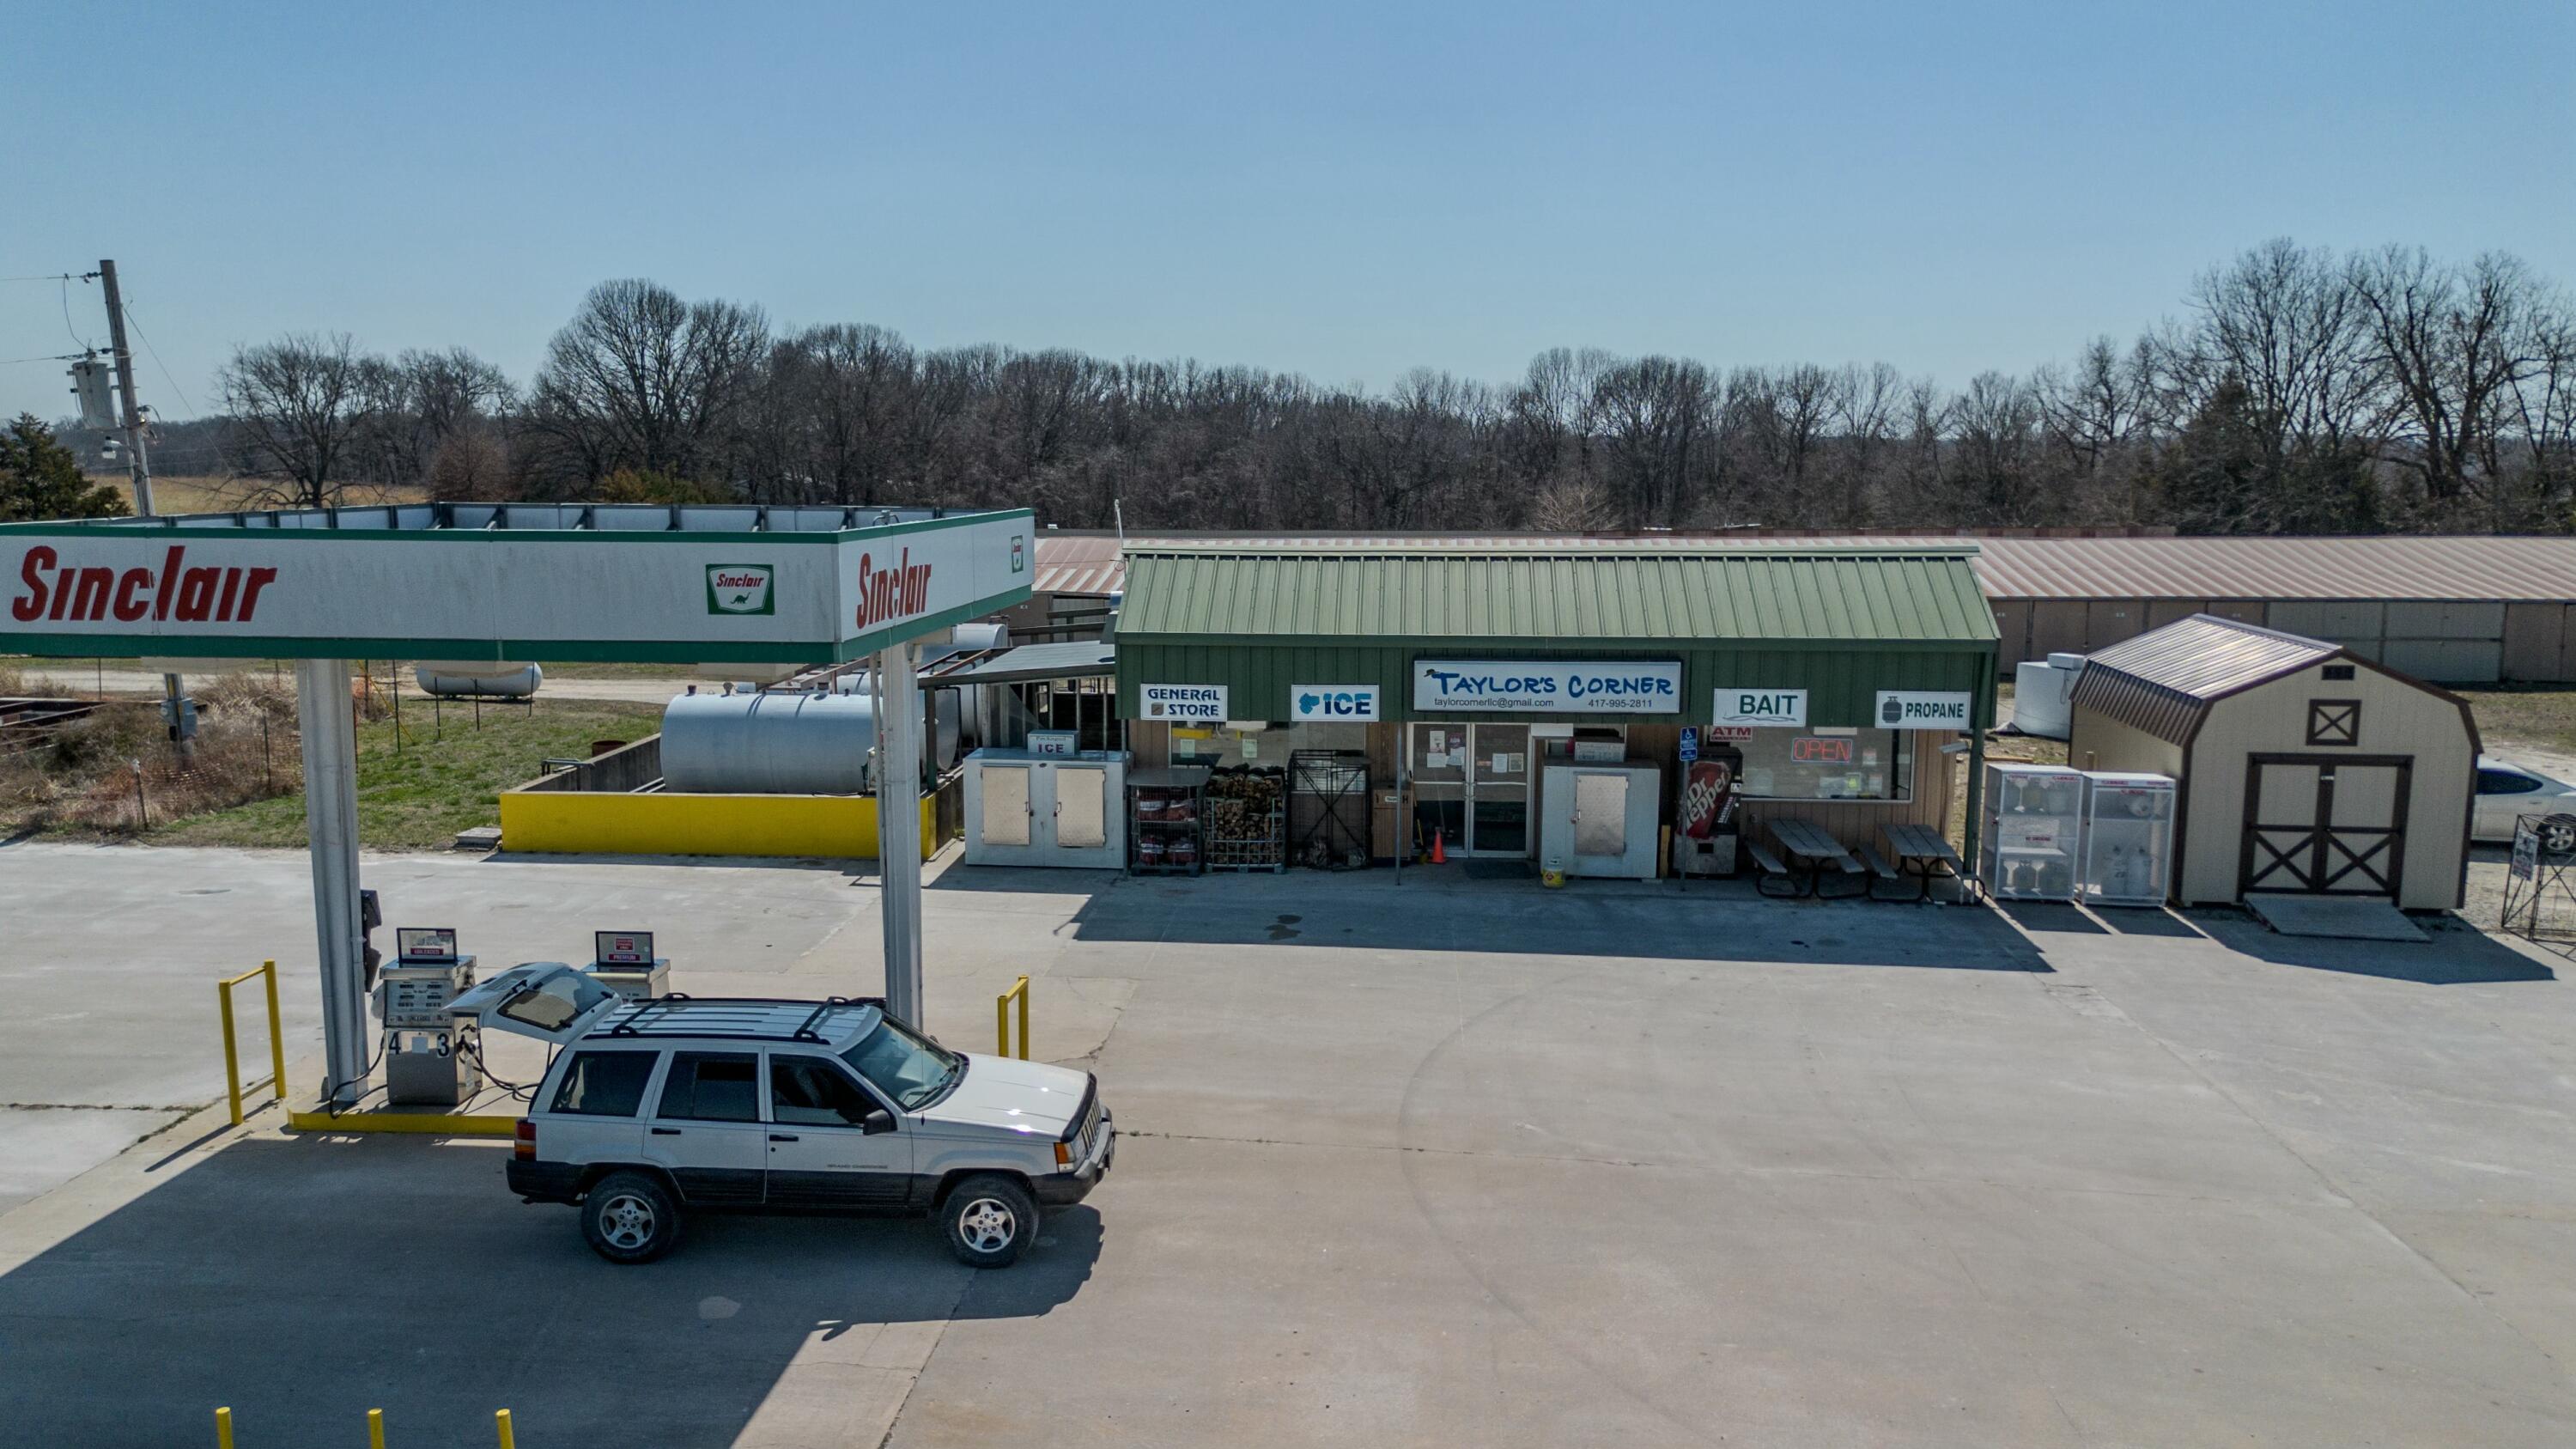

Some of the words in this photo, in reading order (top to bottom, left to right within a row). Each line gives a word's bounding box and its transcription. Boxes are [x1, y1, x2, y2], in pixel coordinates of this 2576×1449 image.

[12, 545, 278, 622] Sinclair
[716, 573, 765, 588] Sinclair
[856, 546, 932, 630] Sinclair
[1147, 688, 1220, 701] GENERAL
[1568, 675, 1674, 698] CORNER
[1169, 703, 1219, 716] STORE
[1323, 692, 1371, 715] ICE
[1588, 699, 1652, 708] 417-995-2811
[1739, 694, 1798, 715] BAIT
[1905, 702, 1965, 719] PROPANE
[1712, 728, 1752, 736] ATM
[1038, 743, 1065, 753] ICE
[1794, 739, 1851, 761] OPEN
[389, 1032, 401, 1055] 4
[437, 1032, 450, 1057] 3
